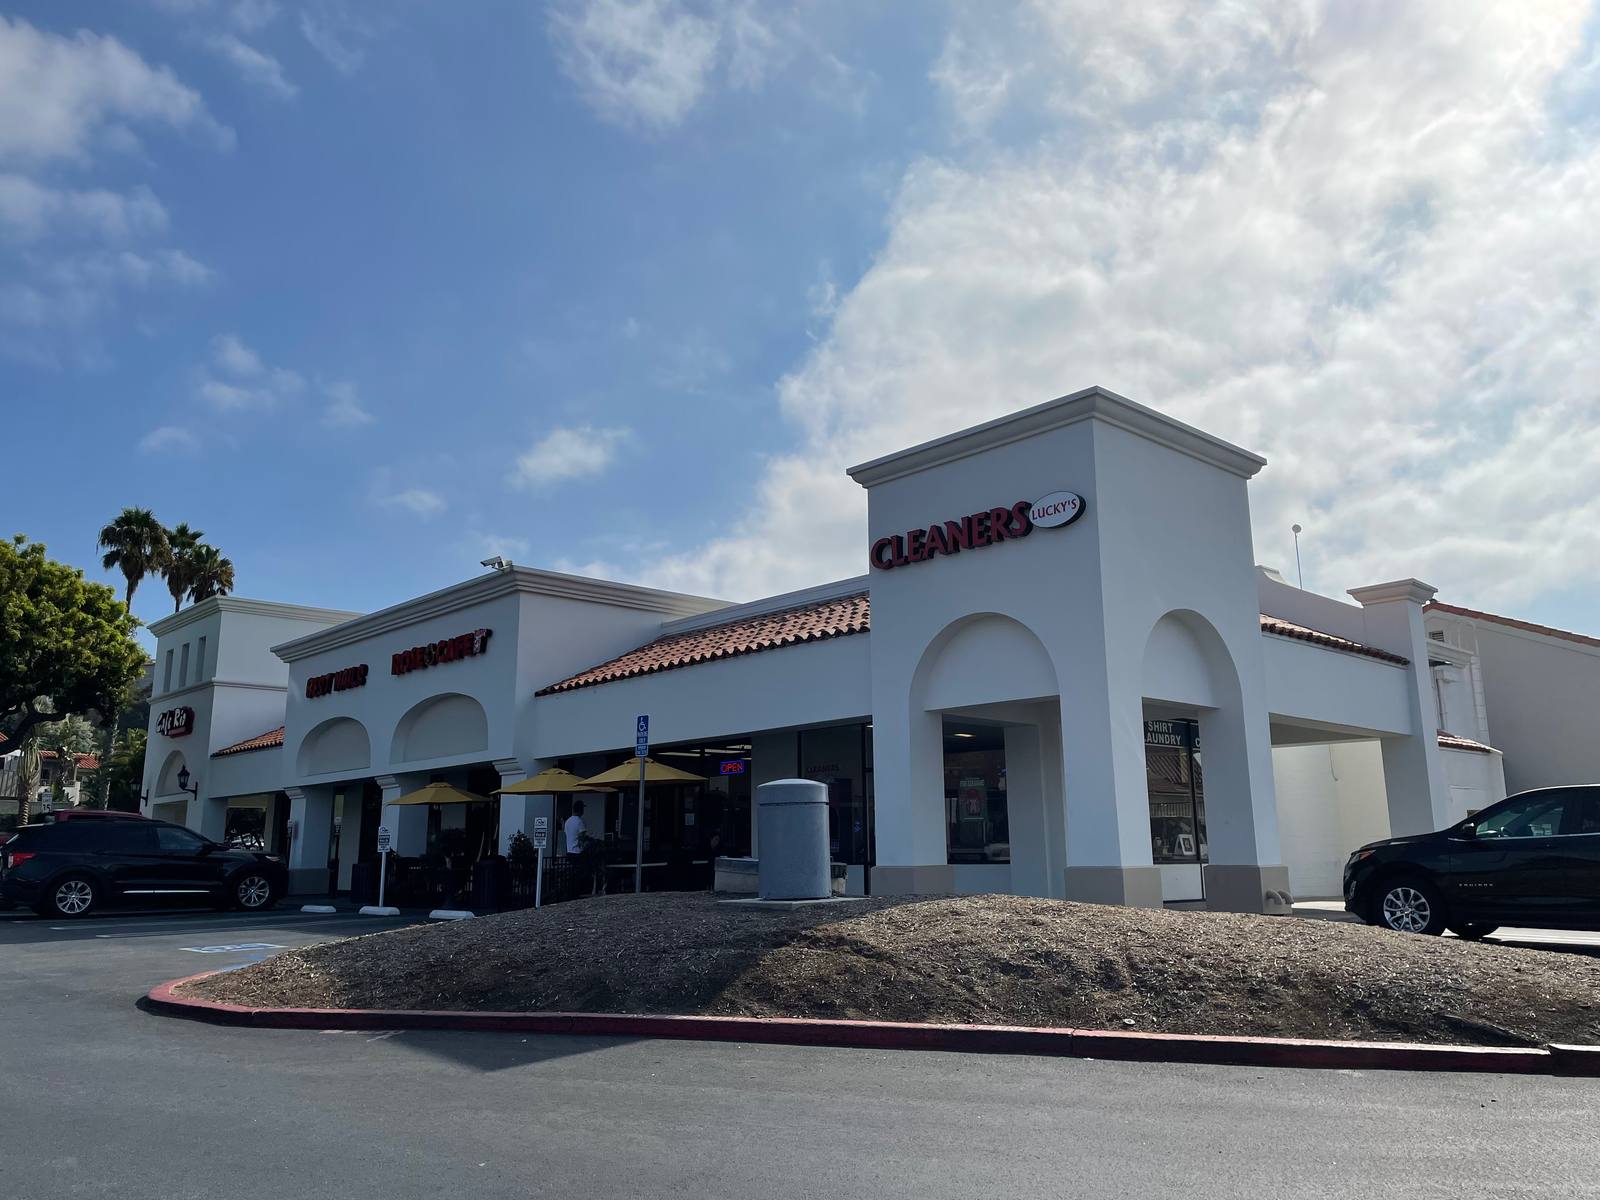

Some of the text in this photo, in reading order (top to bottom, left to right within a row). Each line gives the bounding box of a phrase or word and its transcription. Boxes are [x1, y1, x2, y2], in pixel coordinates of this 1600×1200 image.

[1031, 498, 1077, 521] LUCKY'S
[871, 500, 1034, 570] CLEANERS
[1147, 720, 1173, 733] SHIRT
[1145, 732, 1181, 745] AUNDRY
[721, 762, 743, 773] OPEN
